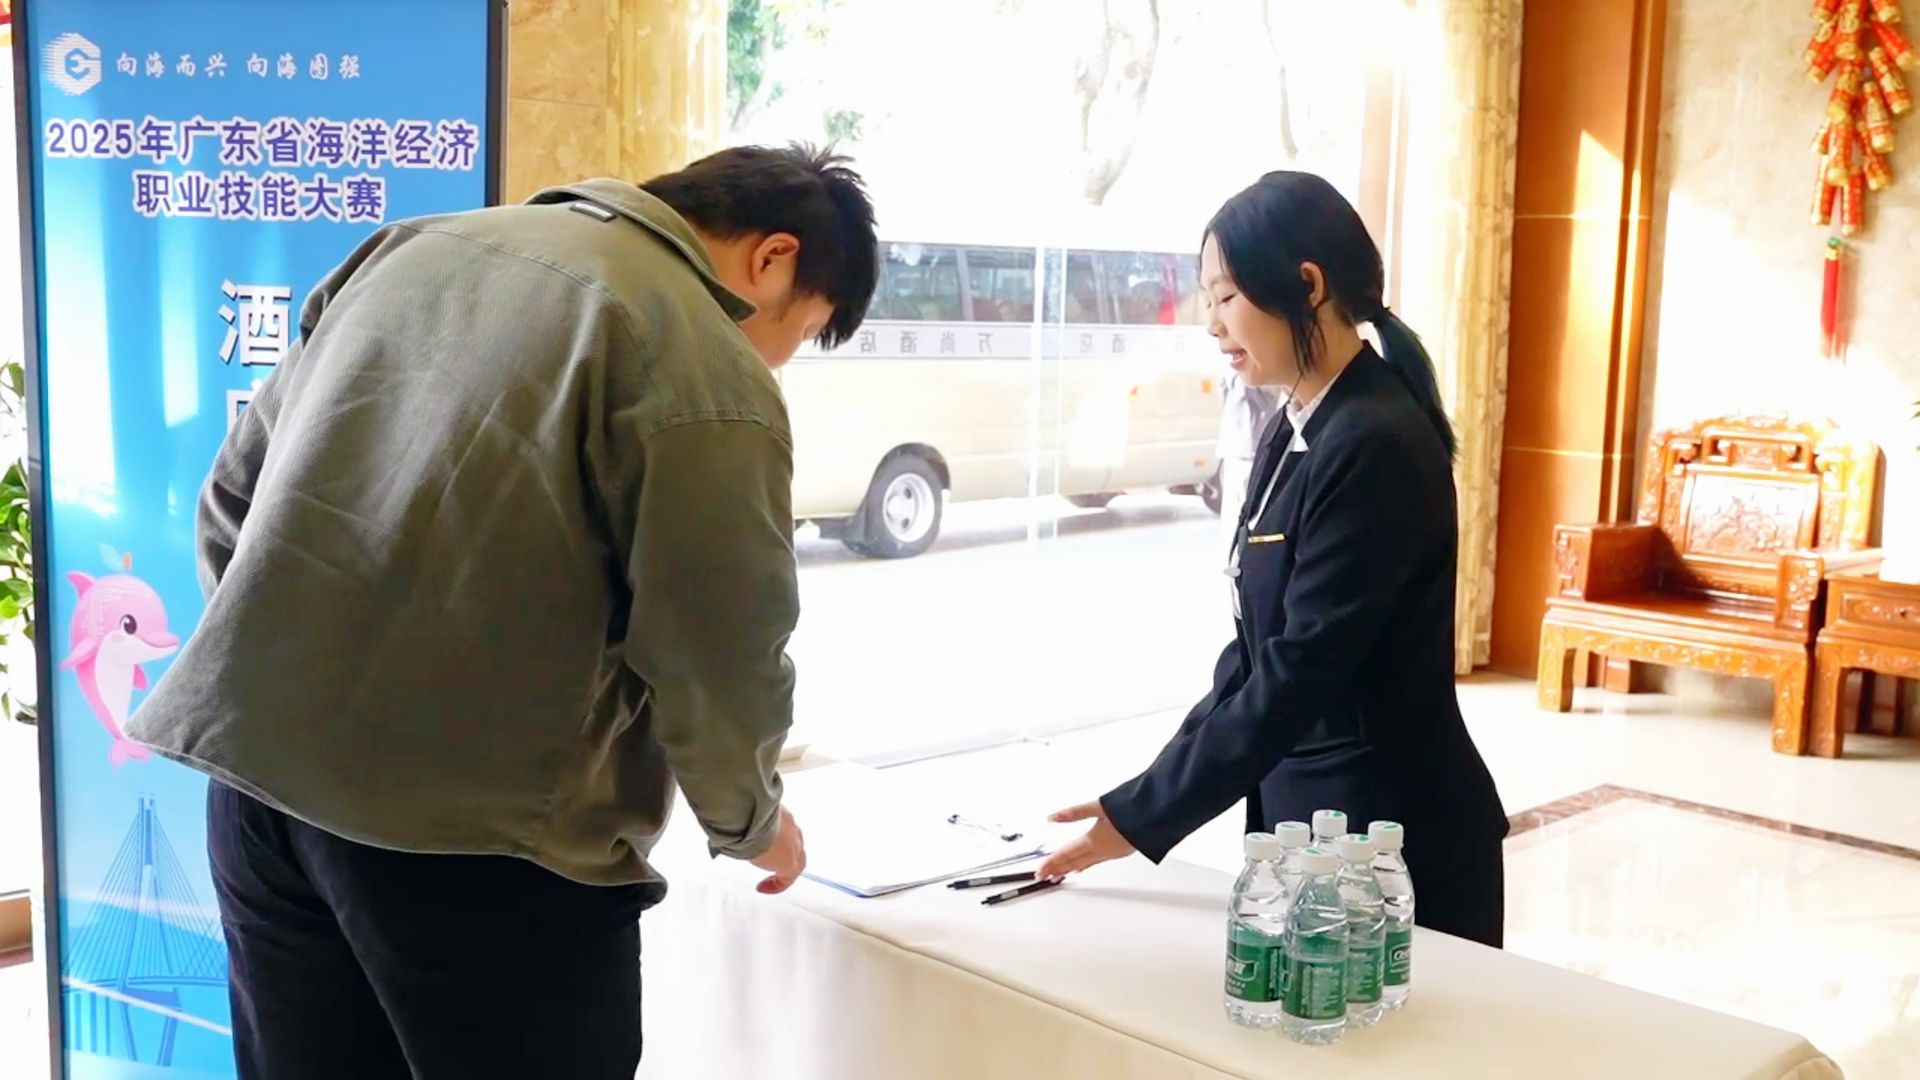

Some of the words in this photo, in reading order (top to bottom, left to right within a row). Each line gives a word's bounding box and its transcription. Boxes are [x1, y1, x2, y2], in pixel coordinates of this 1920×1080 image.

[116, 52, 227, 78] 向海而兴
[246, 52, 360, 80] 向海图强
[47, 117, 477, 168] 2025年广东省海洋经济
[134, 172, 384, 221] 职业技能大赛
